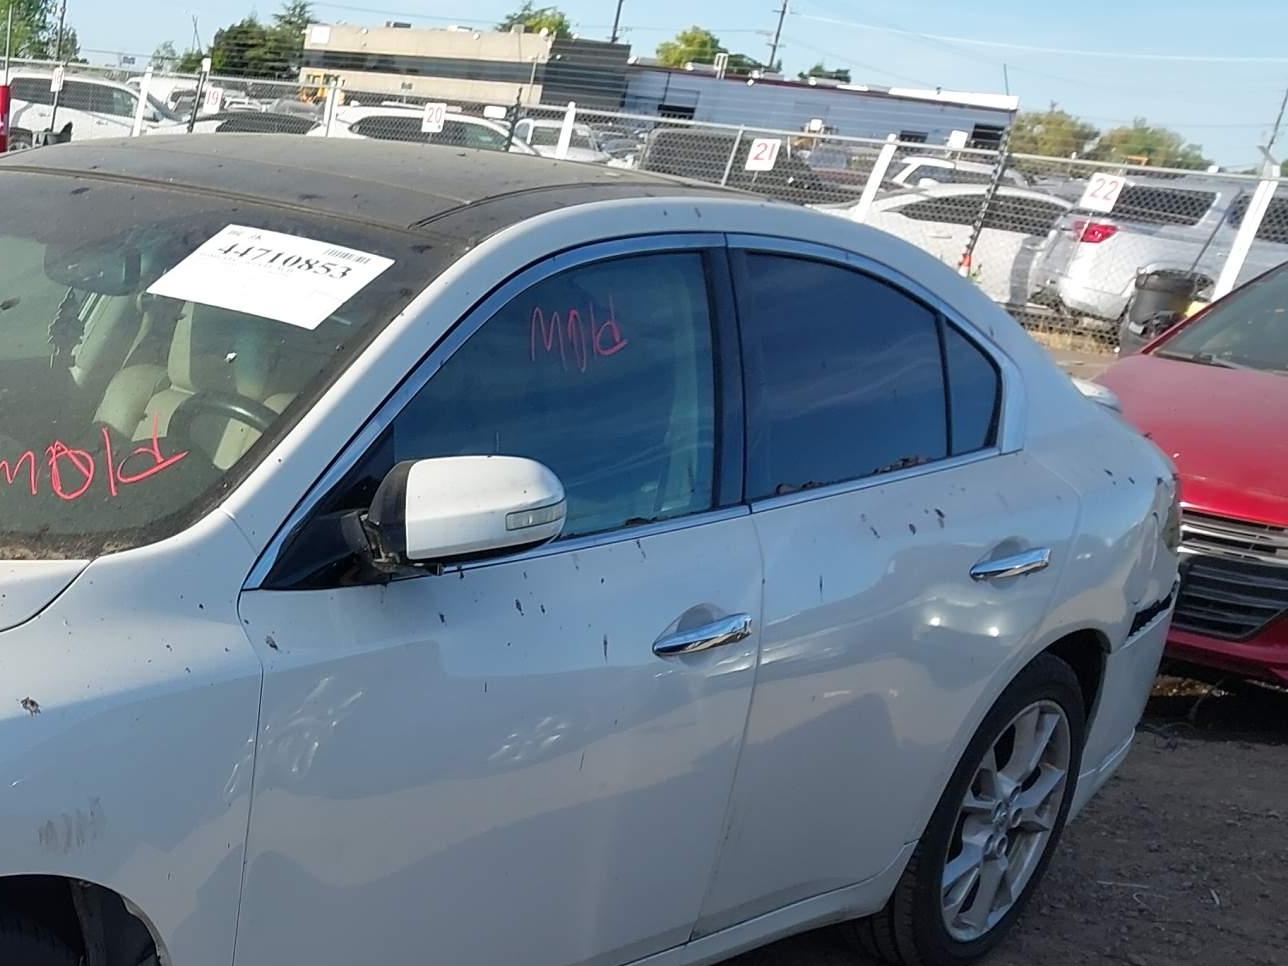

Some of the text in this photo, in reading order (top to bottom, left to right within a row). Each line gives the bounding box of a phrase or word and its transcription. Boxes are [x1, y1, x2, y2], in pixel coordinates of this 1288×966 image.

[207, 90, 219, 105] 19
[427, 107, 442, 123] 20
[753, 142, 776, 160] 21
[1090, 177, 1119, 200] 22
[217, 242, 353, 280] 44710853
